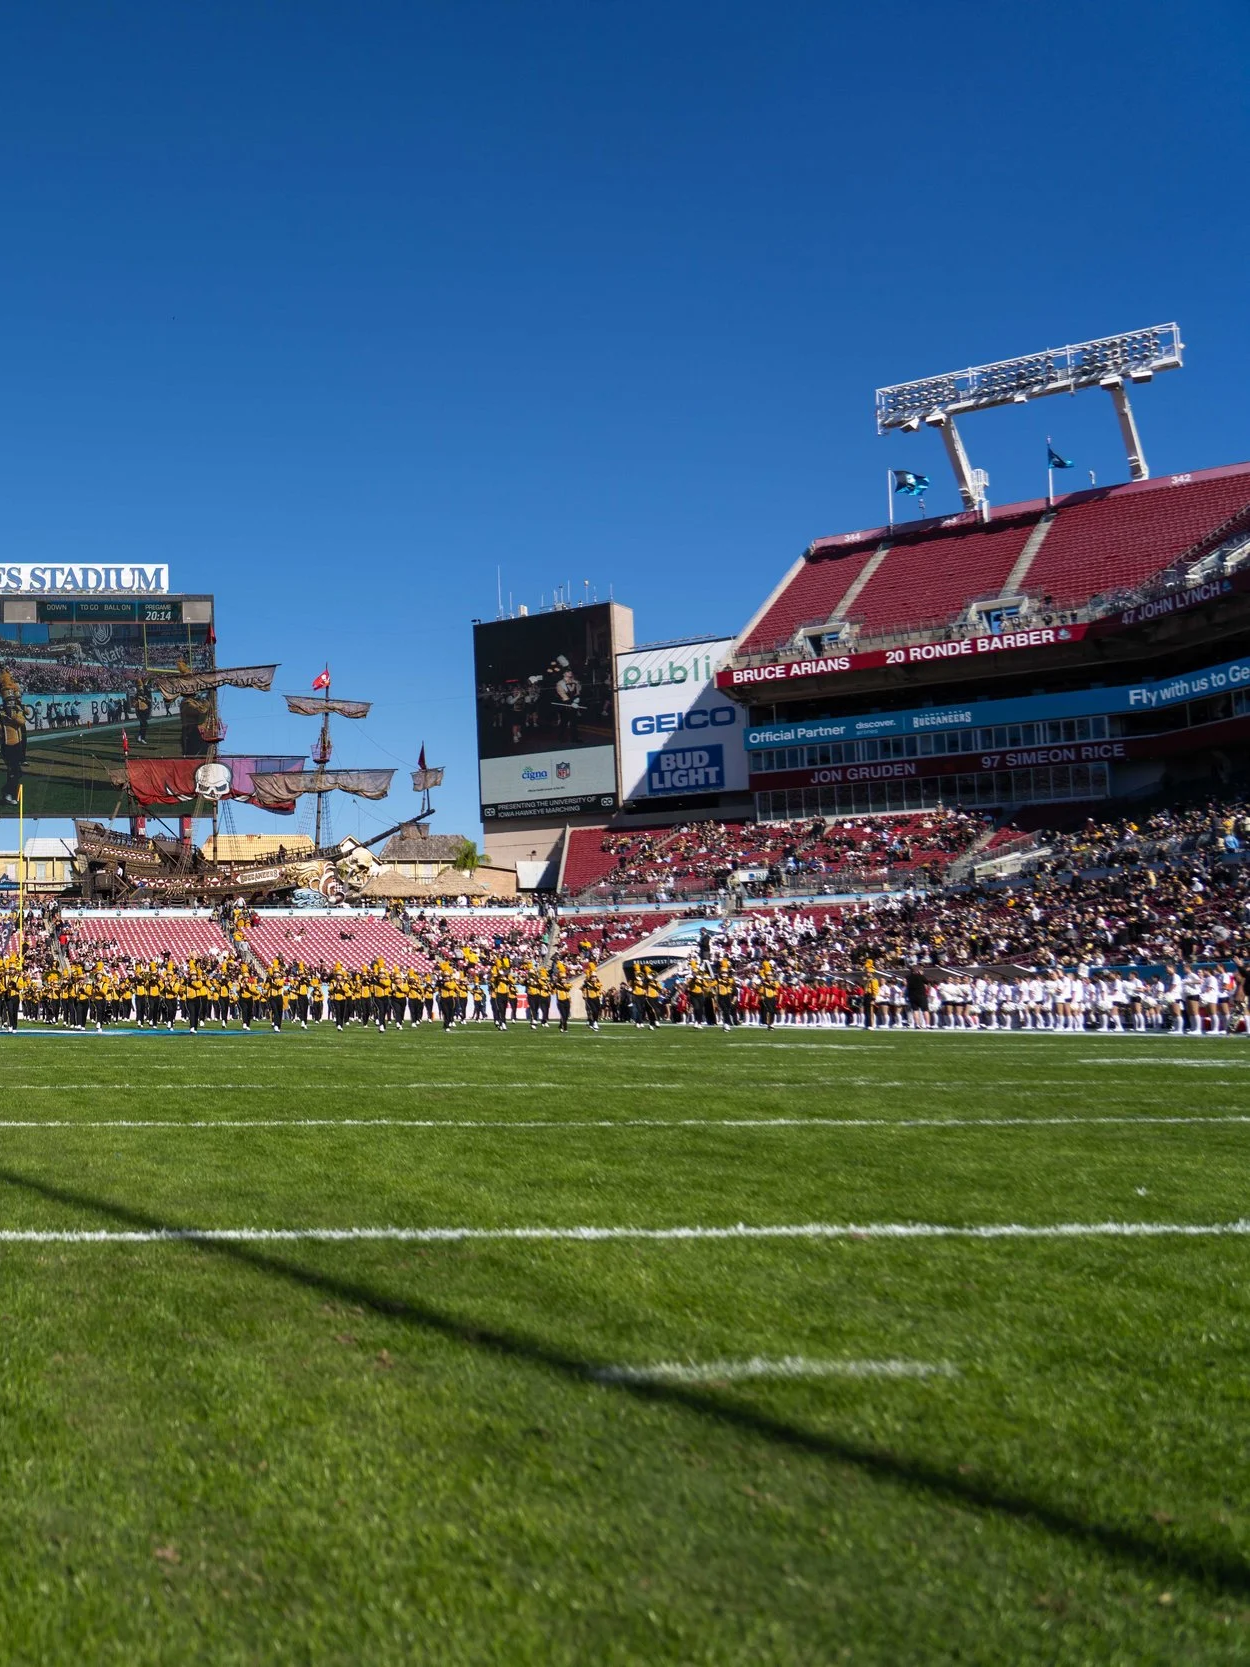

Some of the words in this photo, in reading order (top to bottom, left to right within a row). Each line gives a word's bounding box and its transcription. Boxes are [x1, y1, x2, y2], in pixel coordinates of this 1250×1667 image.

[1171, 473, 1192, 484] 342
[30, 565, 164, 591] STADIUM
[1122, 611, 1135, 625] 47
[1138, 599, 1173, 621] JOHN
[1175, 581, 1221, 608] LYNCH
[145, 611, 172, 621] 20:14
[885, 649, 905, 664] 20
[909, 641, 972, 661] RONDÉ
[977, 629, 1055, 652] BARBER
[623, 654, 712, 691] Publi
[733, 665, 786, 683] BRUCE
[790, 657, 850, 676] ARIANS
[1129, 688, 1158, 707] Fly
[1159, 680, 1190, 700] with
[1191, 678, 1209, 692] us
[1210, 673, 1227, 687] to
[631, 706, 736, 736] GEICO
[913, 711, 972, 728] BUCCANEERS
[749, 730, 796, 744] Official
[797, 725, 846, 739] Partner
[660, 750, 710, 771] BUD
[981, 755, 1000, 769] 97
[1006, 748, 1076, 767] SIMEON
[1081, 744, 1125, 759] RICE
[522, 769, 548, 781] cigna
[651, 767, 720, 789] LIGHT
[810, 770, 842, 784] JON
[846, 763, 916, 781] GRUDEN
[497, 802, 536, 811] PRESENTING
[550, 797, 586, 806] UNIVERSITY
[515, 808, 546, 816] HAWKEYE
[546, 805, 581, 814] MARCHING
